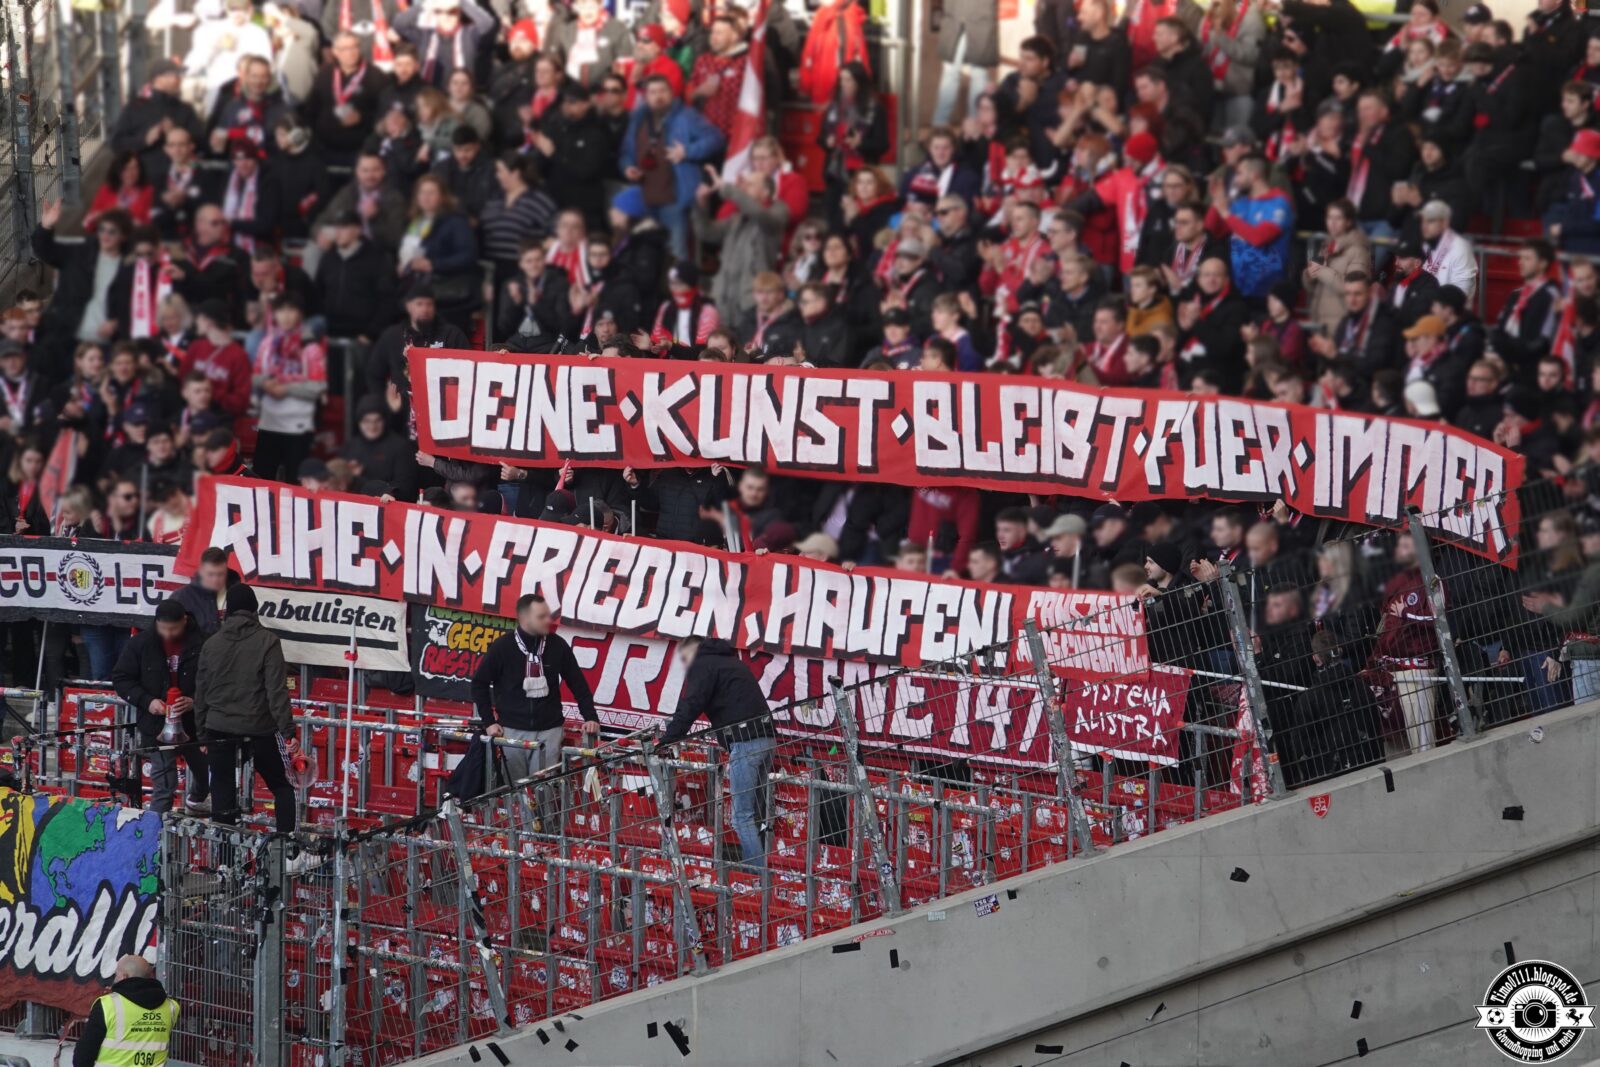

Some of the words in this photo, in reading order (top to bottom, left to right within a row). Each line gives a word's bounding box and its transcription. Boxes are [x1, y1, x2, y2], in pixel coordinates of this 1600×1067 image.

[425, 357, 620, 457] DEINE
[643, 370, 892, 471] KUNST
[913, 380, 1145, 487] BLEIBT
[1144, 399, 1297, 497] FUER
[1313, 412, 1508, 554] IMMER
[209, 483, 382, 590] RUHE
[402, 508, 468, 602] IN
[764, 562, 1014, 669] HAUFEN!
[142, 1012, 161, 1020] SDS
